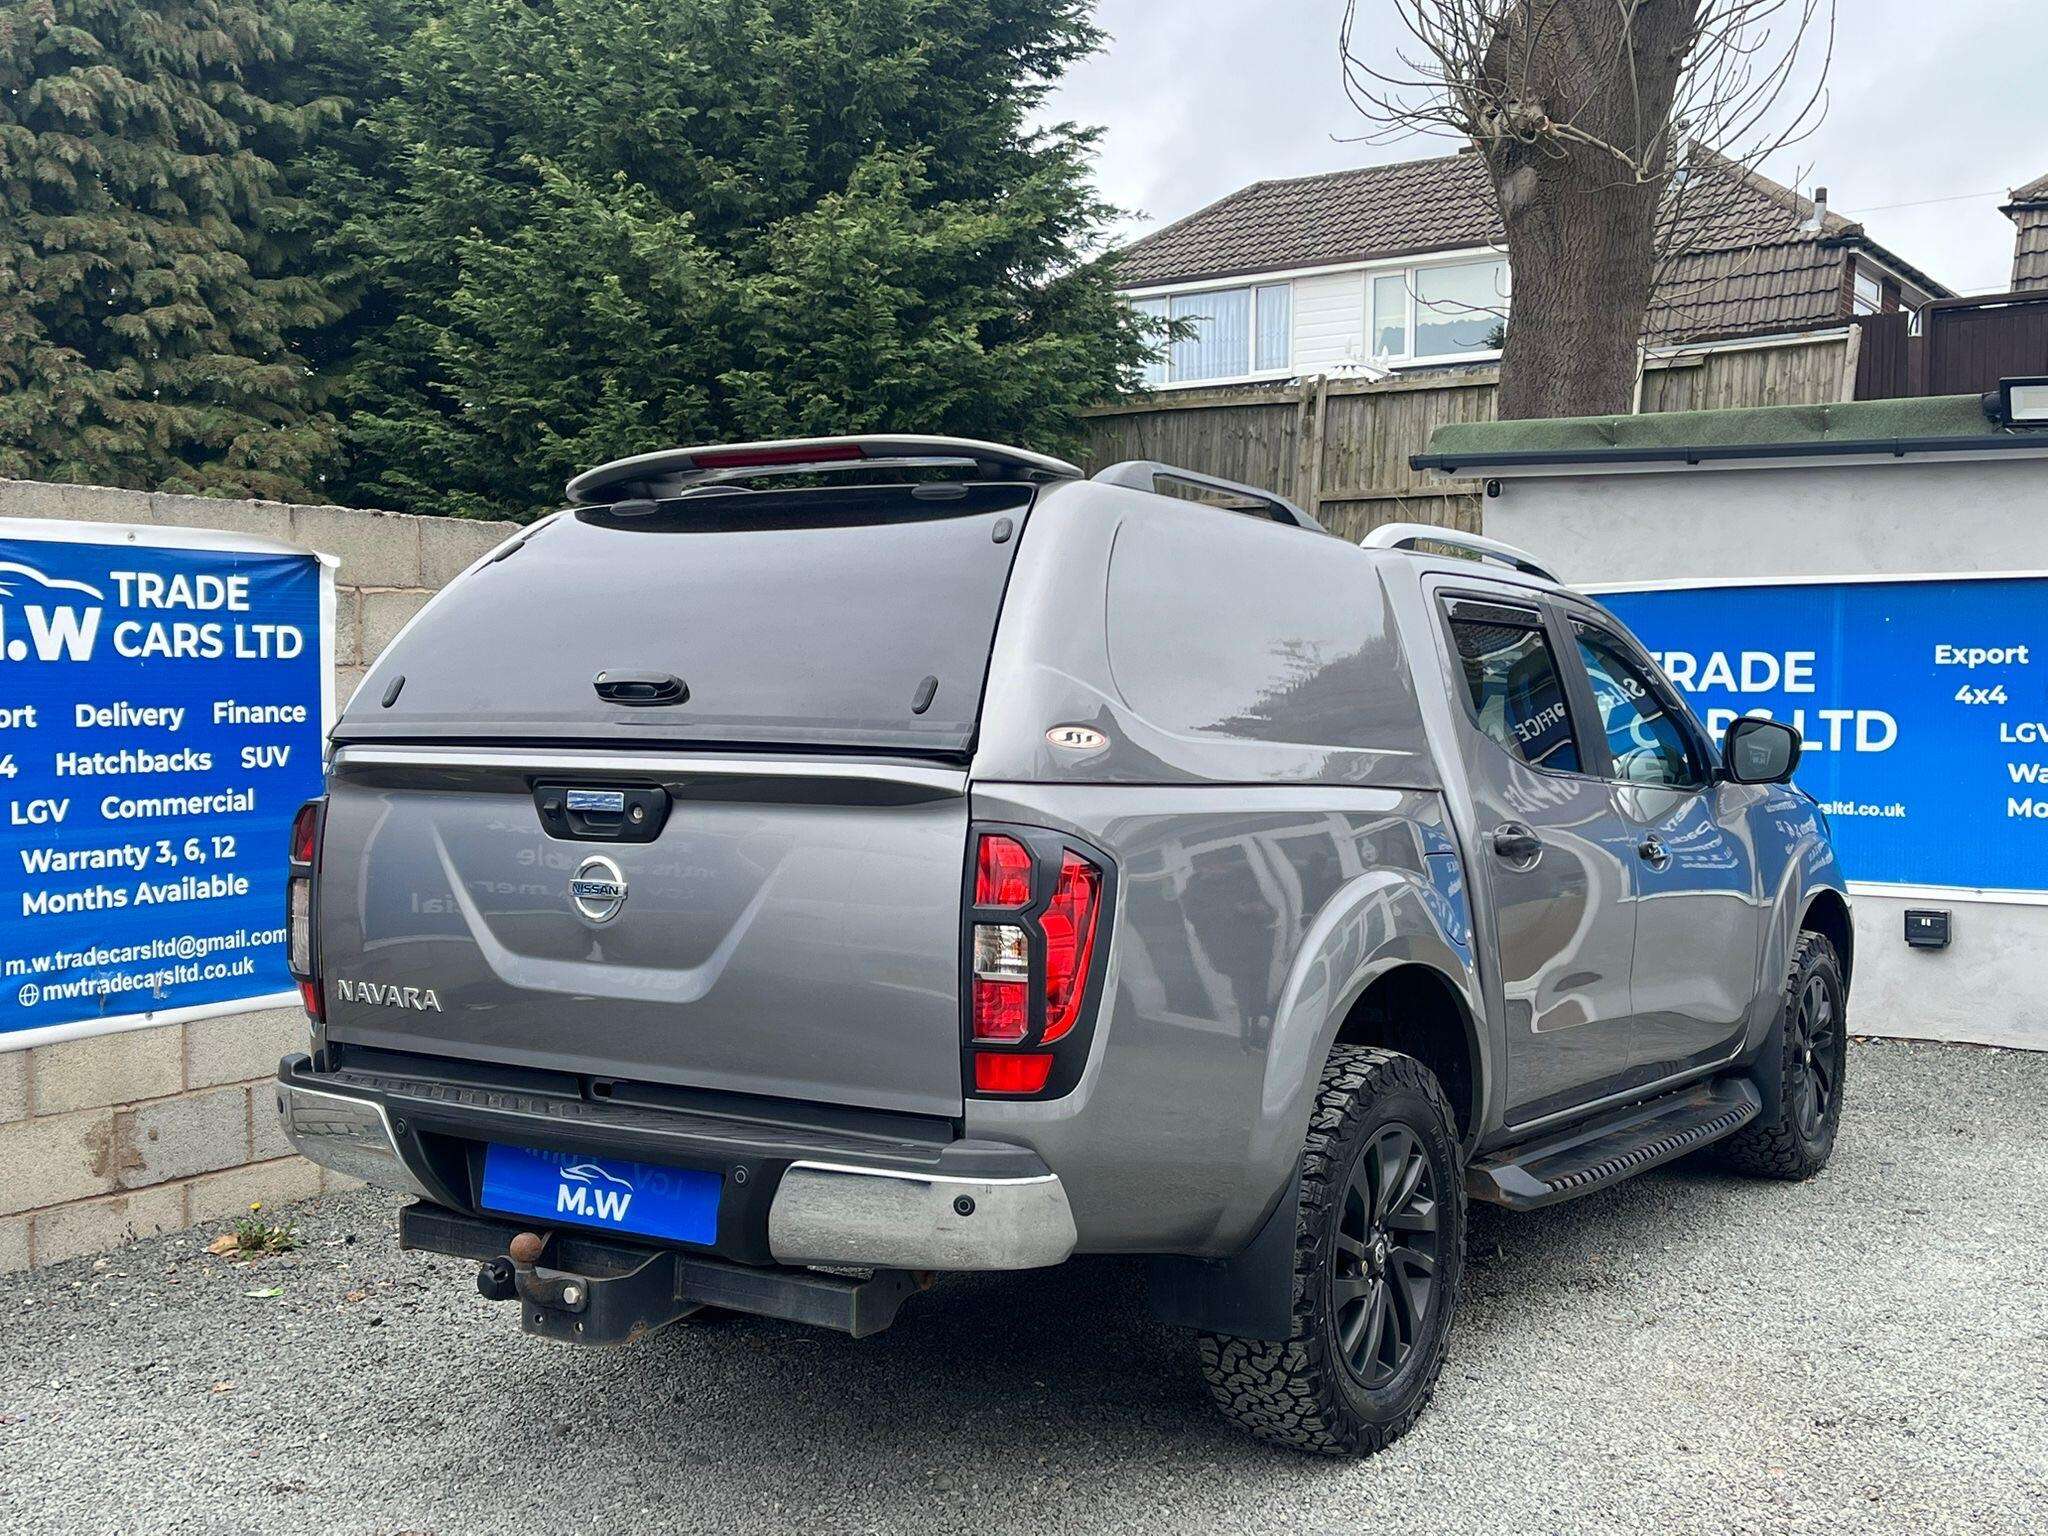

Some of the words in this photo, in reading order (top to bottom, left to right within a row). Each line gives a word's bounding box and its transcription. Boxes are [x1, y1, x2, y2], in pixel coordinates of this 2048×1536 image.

[109, 571, 250, 611] TRADE
[0, 603, 103, 662] .W
[113, 621, 225, 660] CARS
[234, 624, 303, 659] LTD
[1934, 644, 2029, 669] Export
[1954, 684, 2008, 705] 4x4
[75, 701, 185, 731] Delivery
[213, 699, 307, 725] Finance
[1794, 709, 1898, 752] LTD
[55, 748, 213, 777] Hatchbacks
[240, 745, 291, 769] SUV
[10, 798, 70, 825] LGV
[100, 787, 255, 820] Commercial
[20, 845, 150, 874] Warranty
[155, 840, 177, 867] 3,
[183, 837, 206, 864] 6,
[211, 835, 236, 859] 12
[22, 885, 128, 916] Months
[133, 873, 249, 906] Available
[573, 882, 619, 895] NISSAN
[5, 928, 287, 976] m.w.tradecarsltd@gmail.com
[42, 956, 255, 1001] mwtradecarsltd.co.uk
[337, 979, 443, 1012] NAVARA
[556, 1184, 632, 1222] M.W
